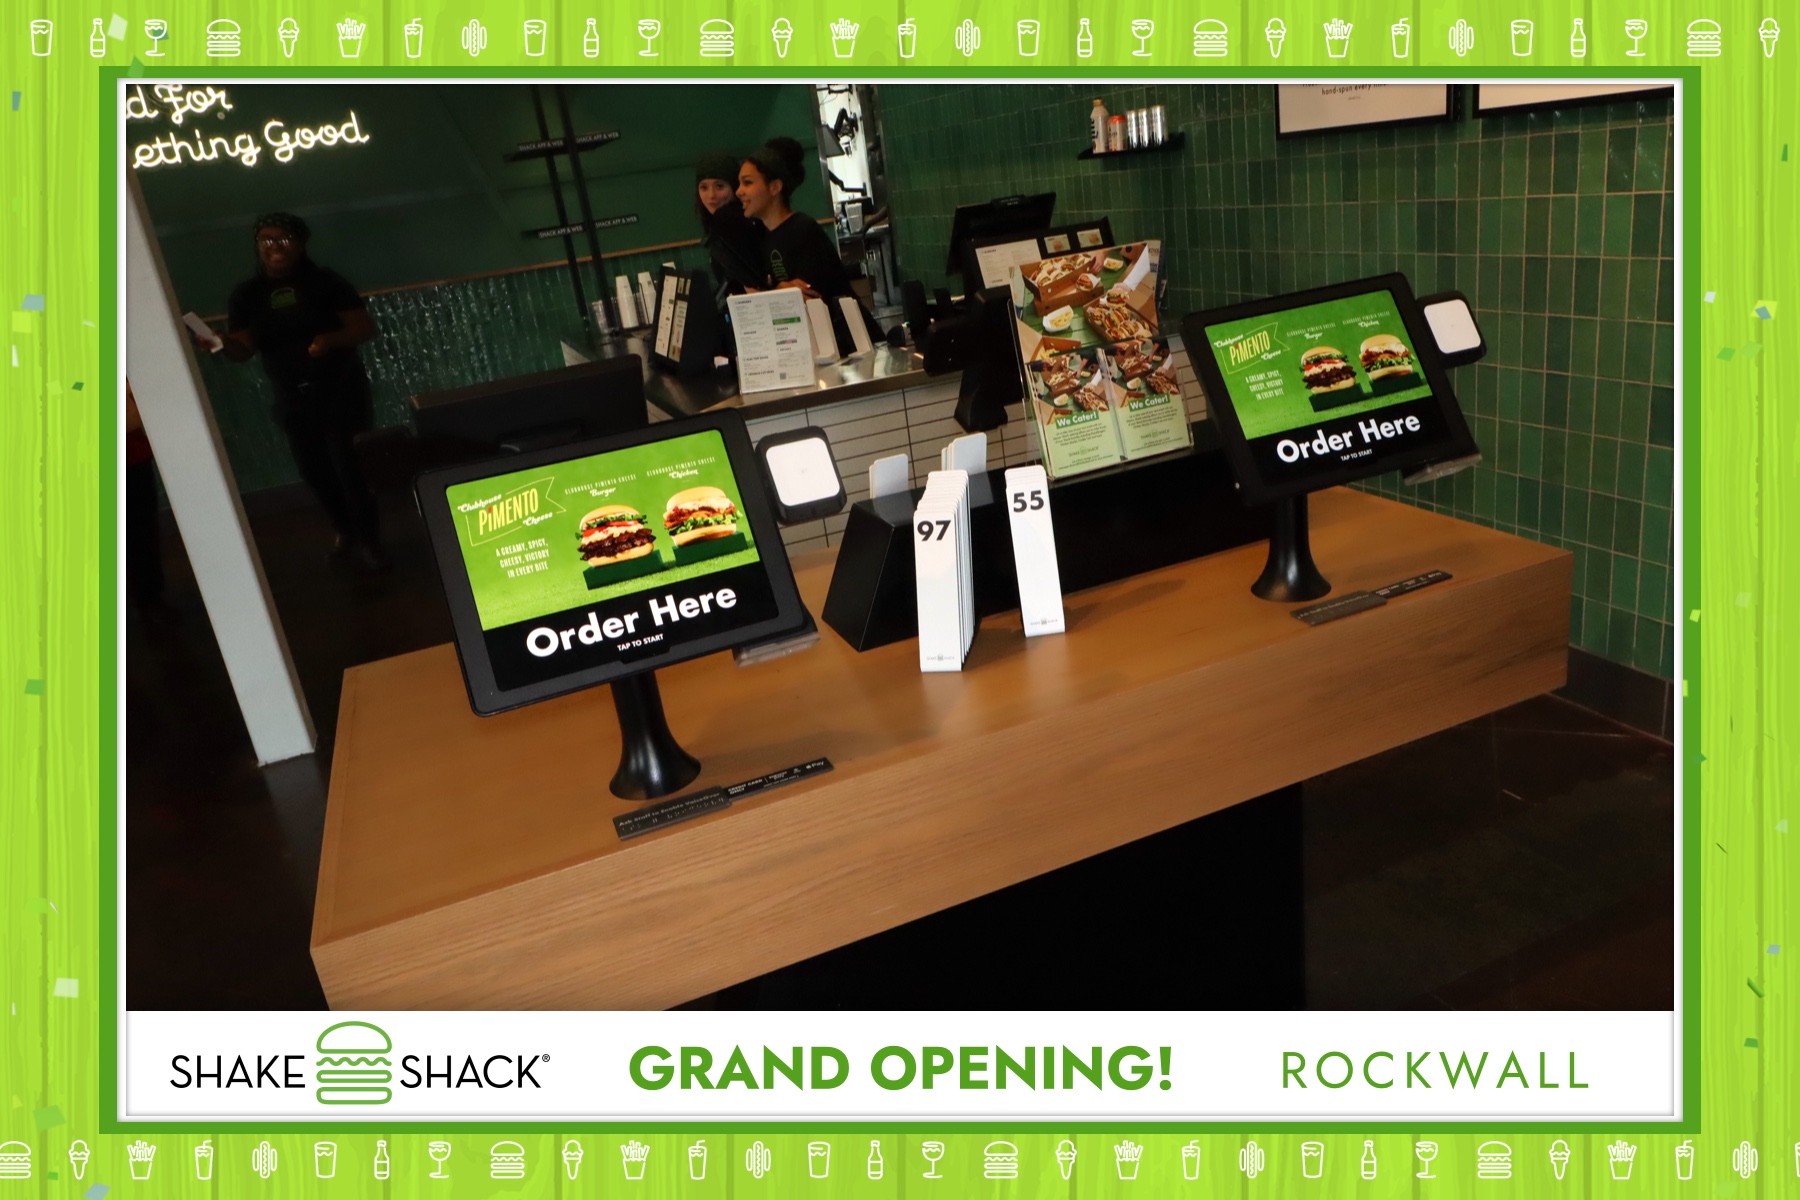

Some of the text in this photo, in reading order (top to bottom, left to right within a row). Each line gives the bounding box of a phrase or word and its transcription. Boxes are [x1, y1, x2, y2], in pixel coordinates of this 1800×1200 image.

[154, 84, 233, 125] For
[132, 109, 370, 168] ething Good
[595, 221, 611, 229] SHACK
[539, 230, 556, 239] SHACK
[1245, 376, 1250, 384] A
[1129, 394, 1169, 410] We Cater!
[1255, 387, 1285, 400] IN EVERY BITE
[1057, 411, 1097, 428] We Cater!
[1276, 415, 1421, 464] Order Here
[1340, 453, 1350, 462] TAP
[1358, 448, 1373, 458] START
[668, 468, 699, 480] Chicken
[589, 486, 617, 498] Burger
[457, 494, 502, 513] Clubhouse
[1012, 490, 1045, 513] 55
[523, 512, 553, 527] Cheese
[917, 519, 952, 542] 97
[495, 537, 549, 557] A CREAMY, SPICY,
[499, 548, 550, 569] CHEESY, VICTORY
[507, 561, 549, 579] IN EVERY BITE
[525, 586, 738, 659] Order Here
[616, 633, 664, 652] TAP TO START
[619, 819, 633, 827] Ask
[633, 813, 651, 822] Staff
[660, 803, 684, 814] Enable
